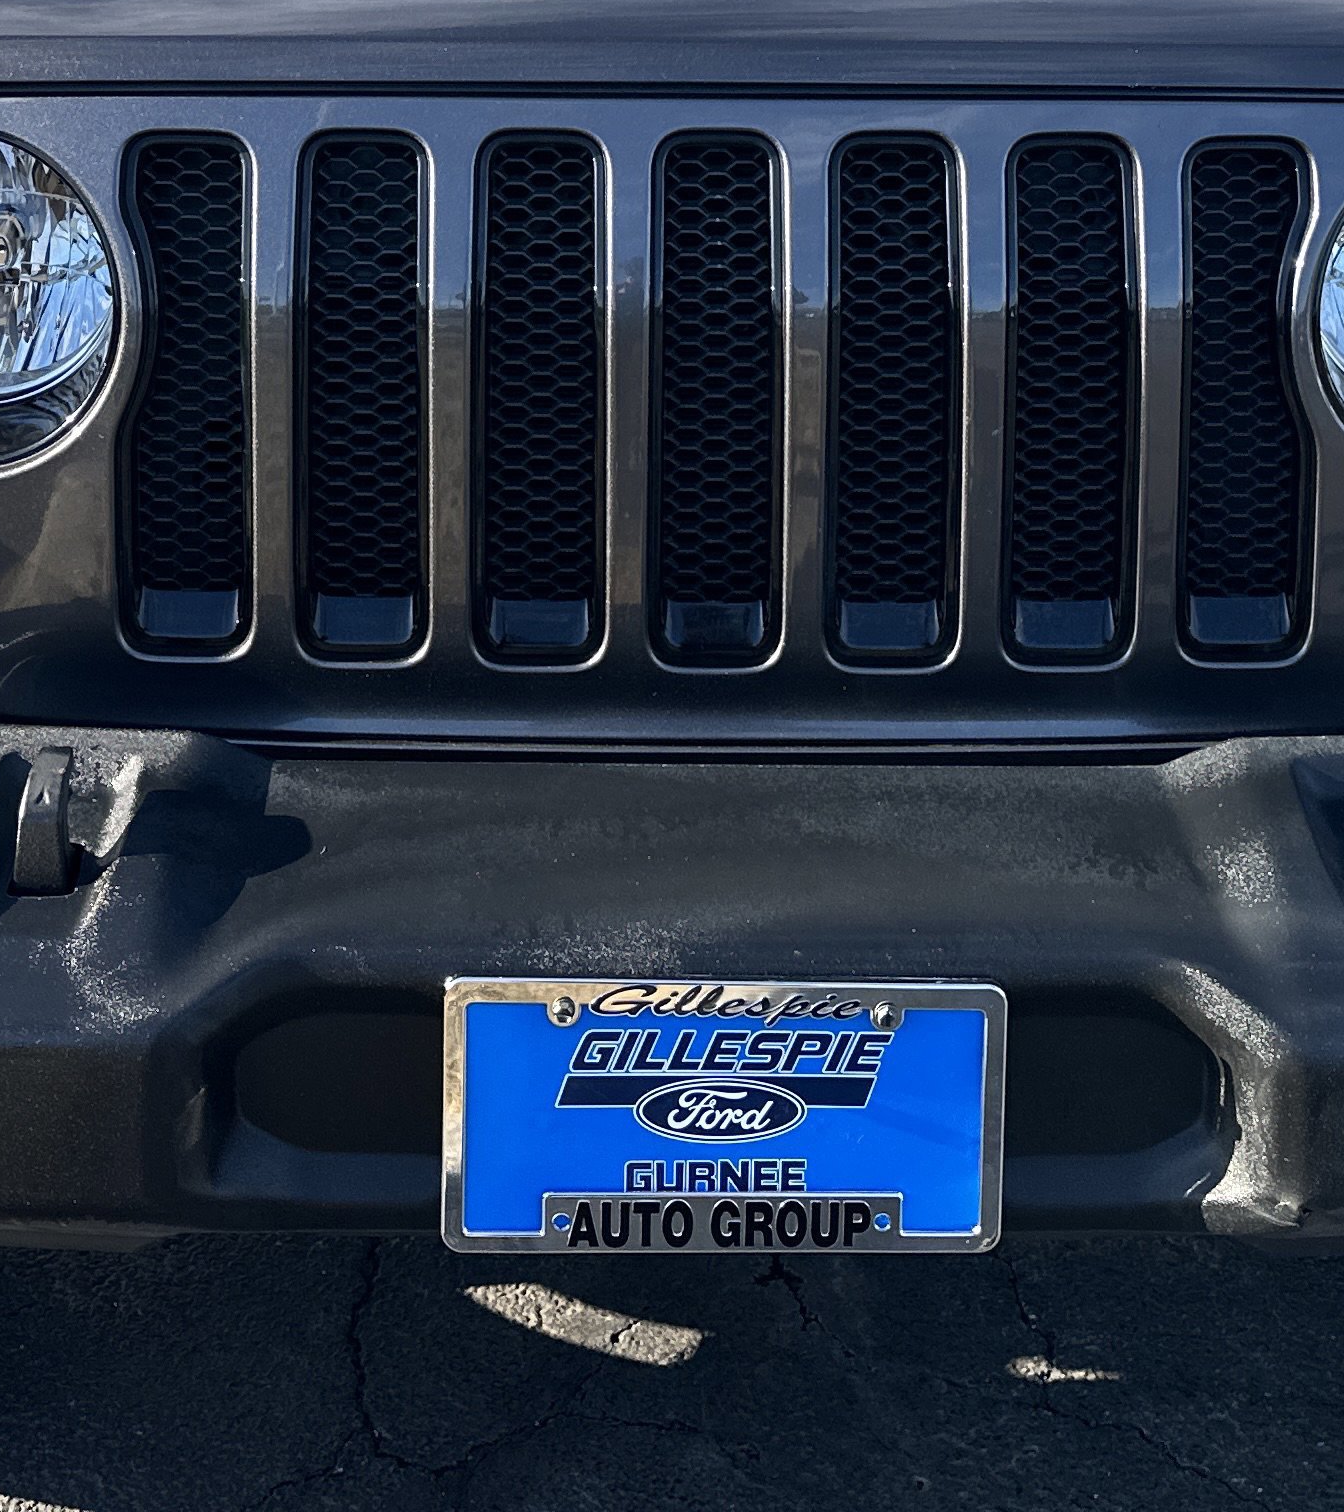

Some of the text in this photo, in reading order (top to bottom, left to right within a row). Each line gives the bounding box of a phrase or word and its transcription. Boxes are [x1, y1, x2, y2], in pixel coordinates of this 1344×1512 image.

[589, 984, 863, 1027] Gillespie
[568, 1028, 895, 1074] GILLESPIE
[667, 1087, 773, 1131] Ford
[623, 1158, 808, 1193] GURNEE
[566, 1198, 873, 1249] AUTO GROUP
